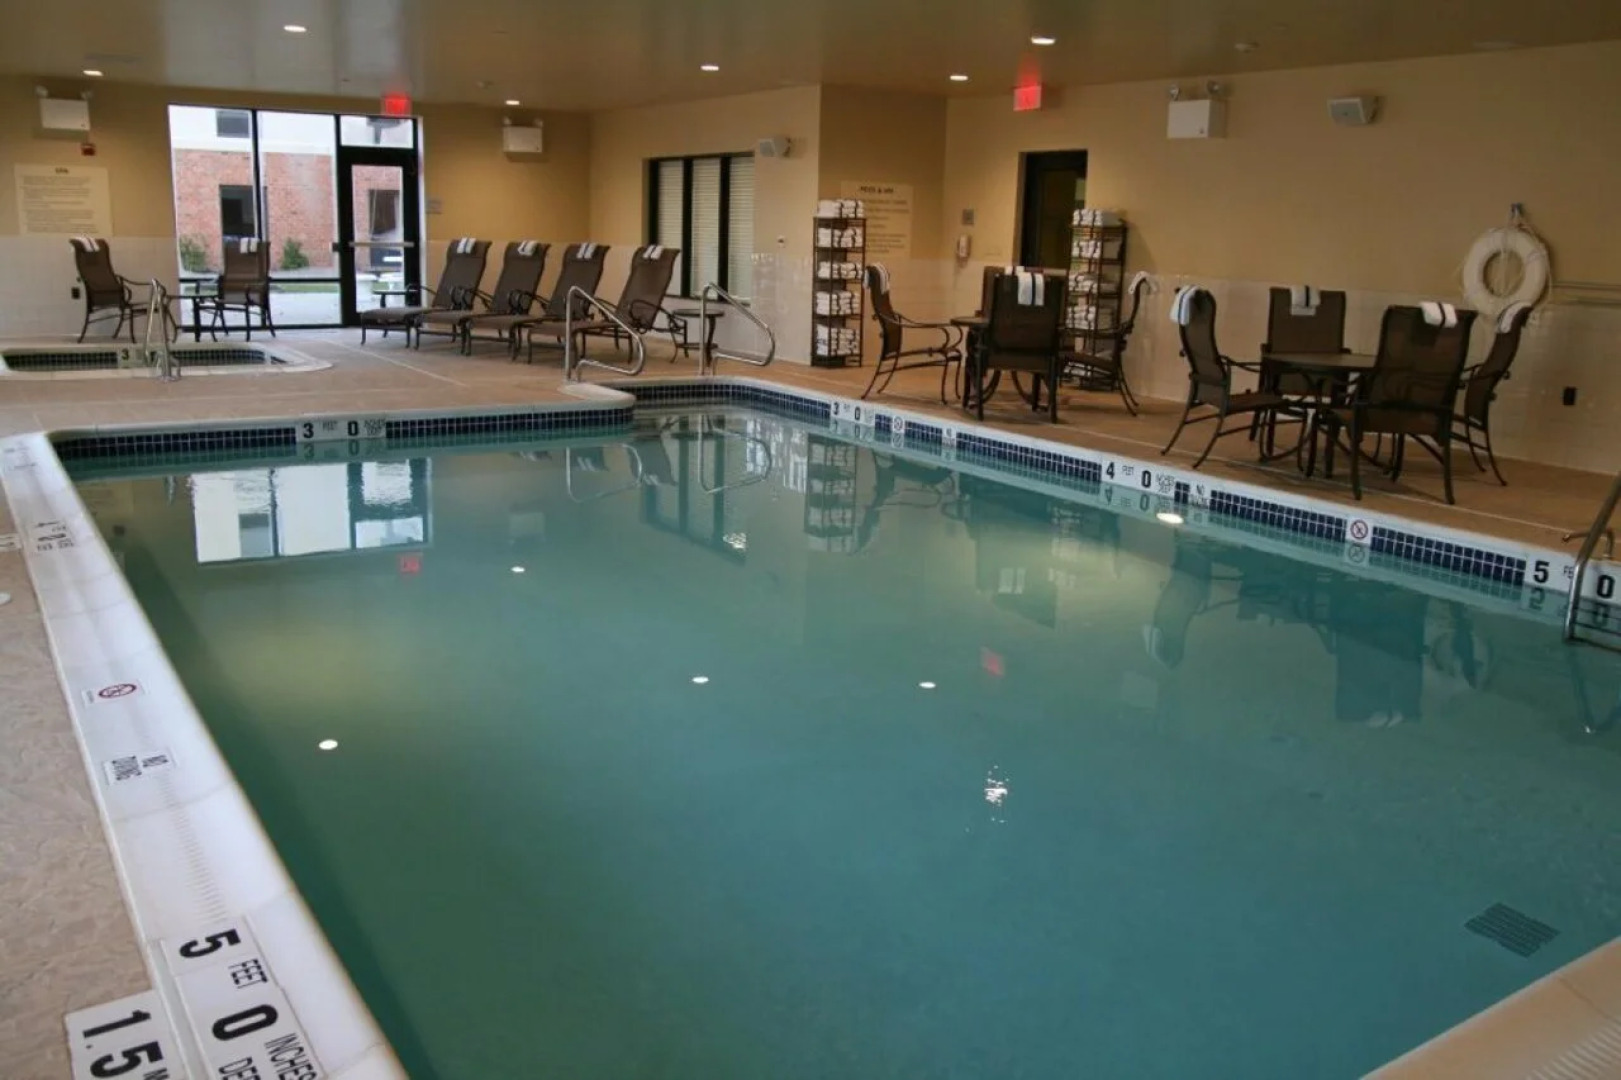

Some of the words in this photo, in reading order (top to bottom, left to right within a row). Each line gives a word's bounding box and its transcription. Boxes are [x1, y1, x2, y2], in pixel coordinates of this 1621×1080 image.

[303, 422, 314, 438] 3
[347, 421, 358, 436] 0
[1106, 461, 1115, 479] 4
[1141, 470, 1151, 488] 0
[1533, 560, 1550, 584] 5
[1596, 574, 1616, 599] 0
[179, 928, 242, 959] 5
[228, 958, 268, 990] FEET
[212, 1004, 279, 1042] 0
